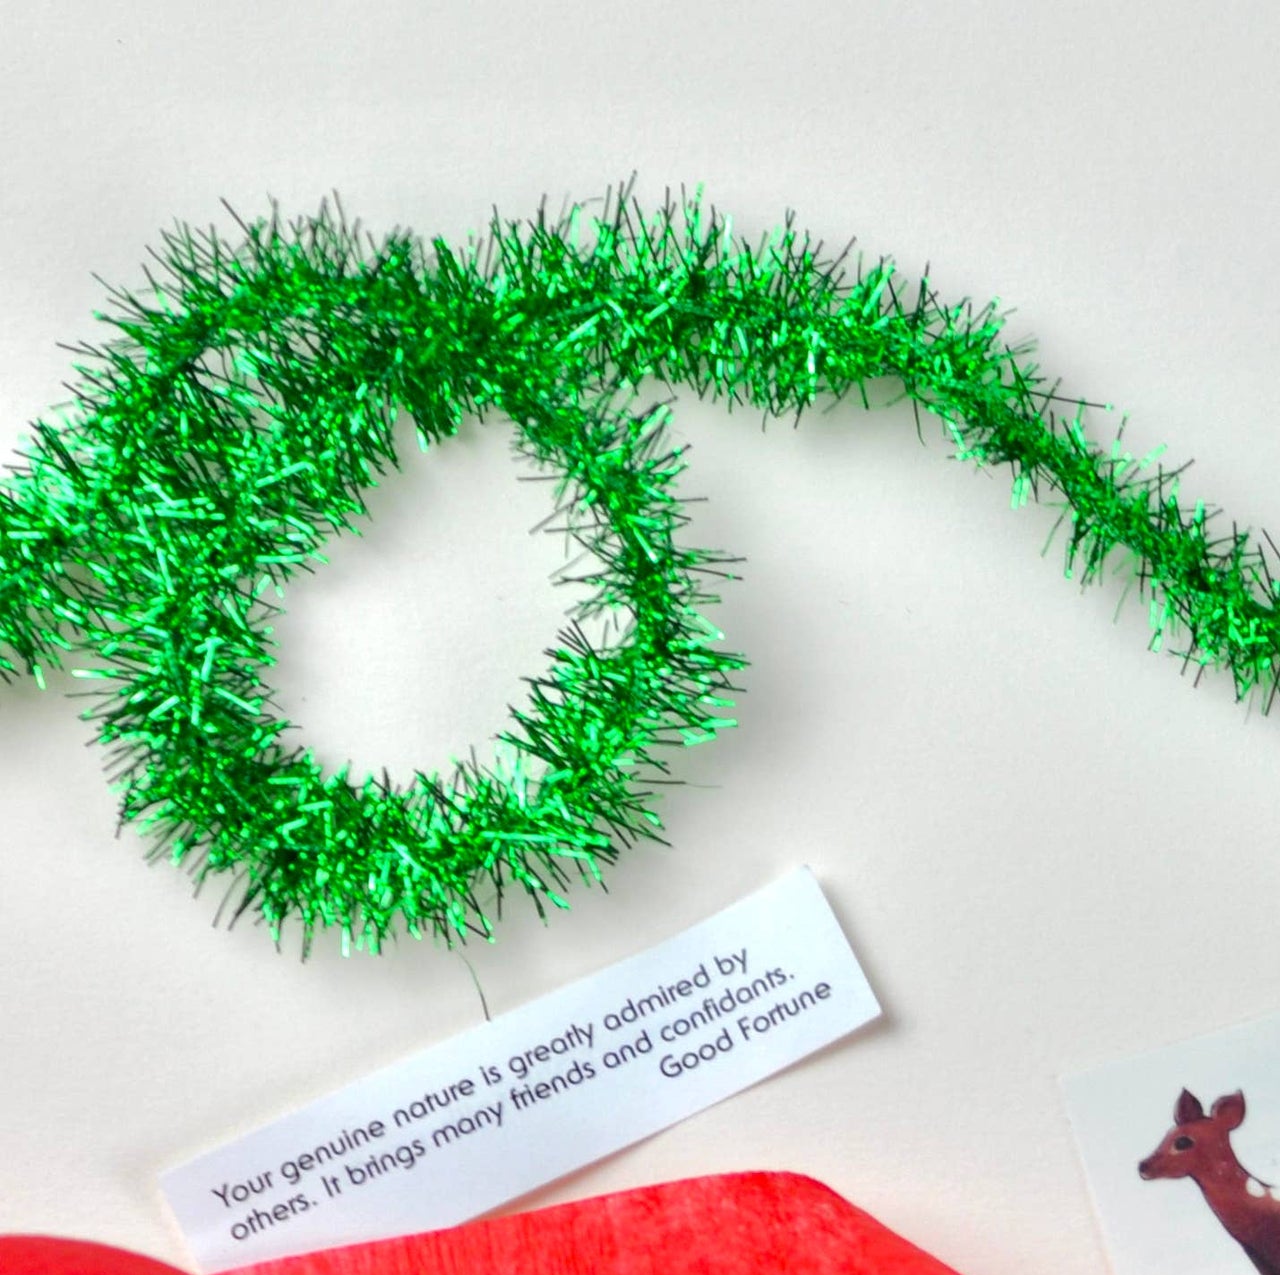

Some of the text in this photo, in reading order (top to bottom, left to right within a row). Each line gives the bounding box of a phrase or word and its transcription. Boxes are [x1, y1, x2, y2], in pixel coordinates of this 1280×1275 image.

[212, 948, 748, 1208] Your genuine nature is greatly admired by
[230, 966, 795, 1240] others. It brings many friends and confidants.
[659, 982, 832, 1078] Good Fortune
